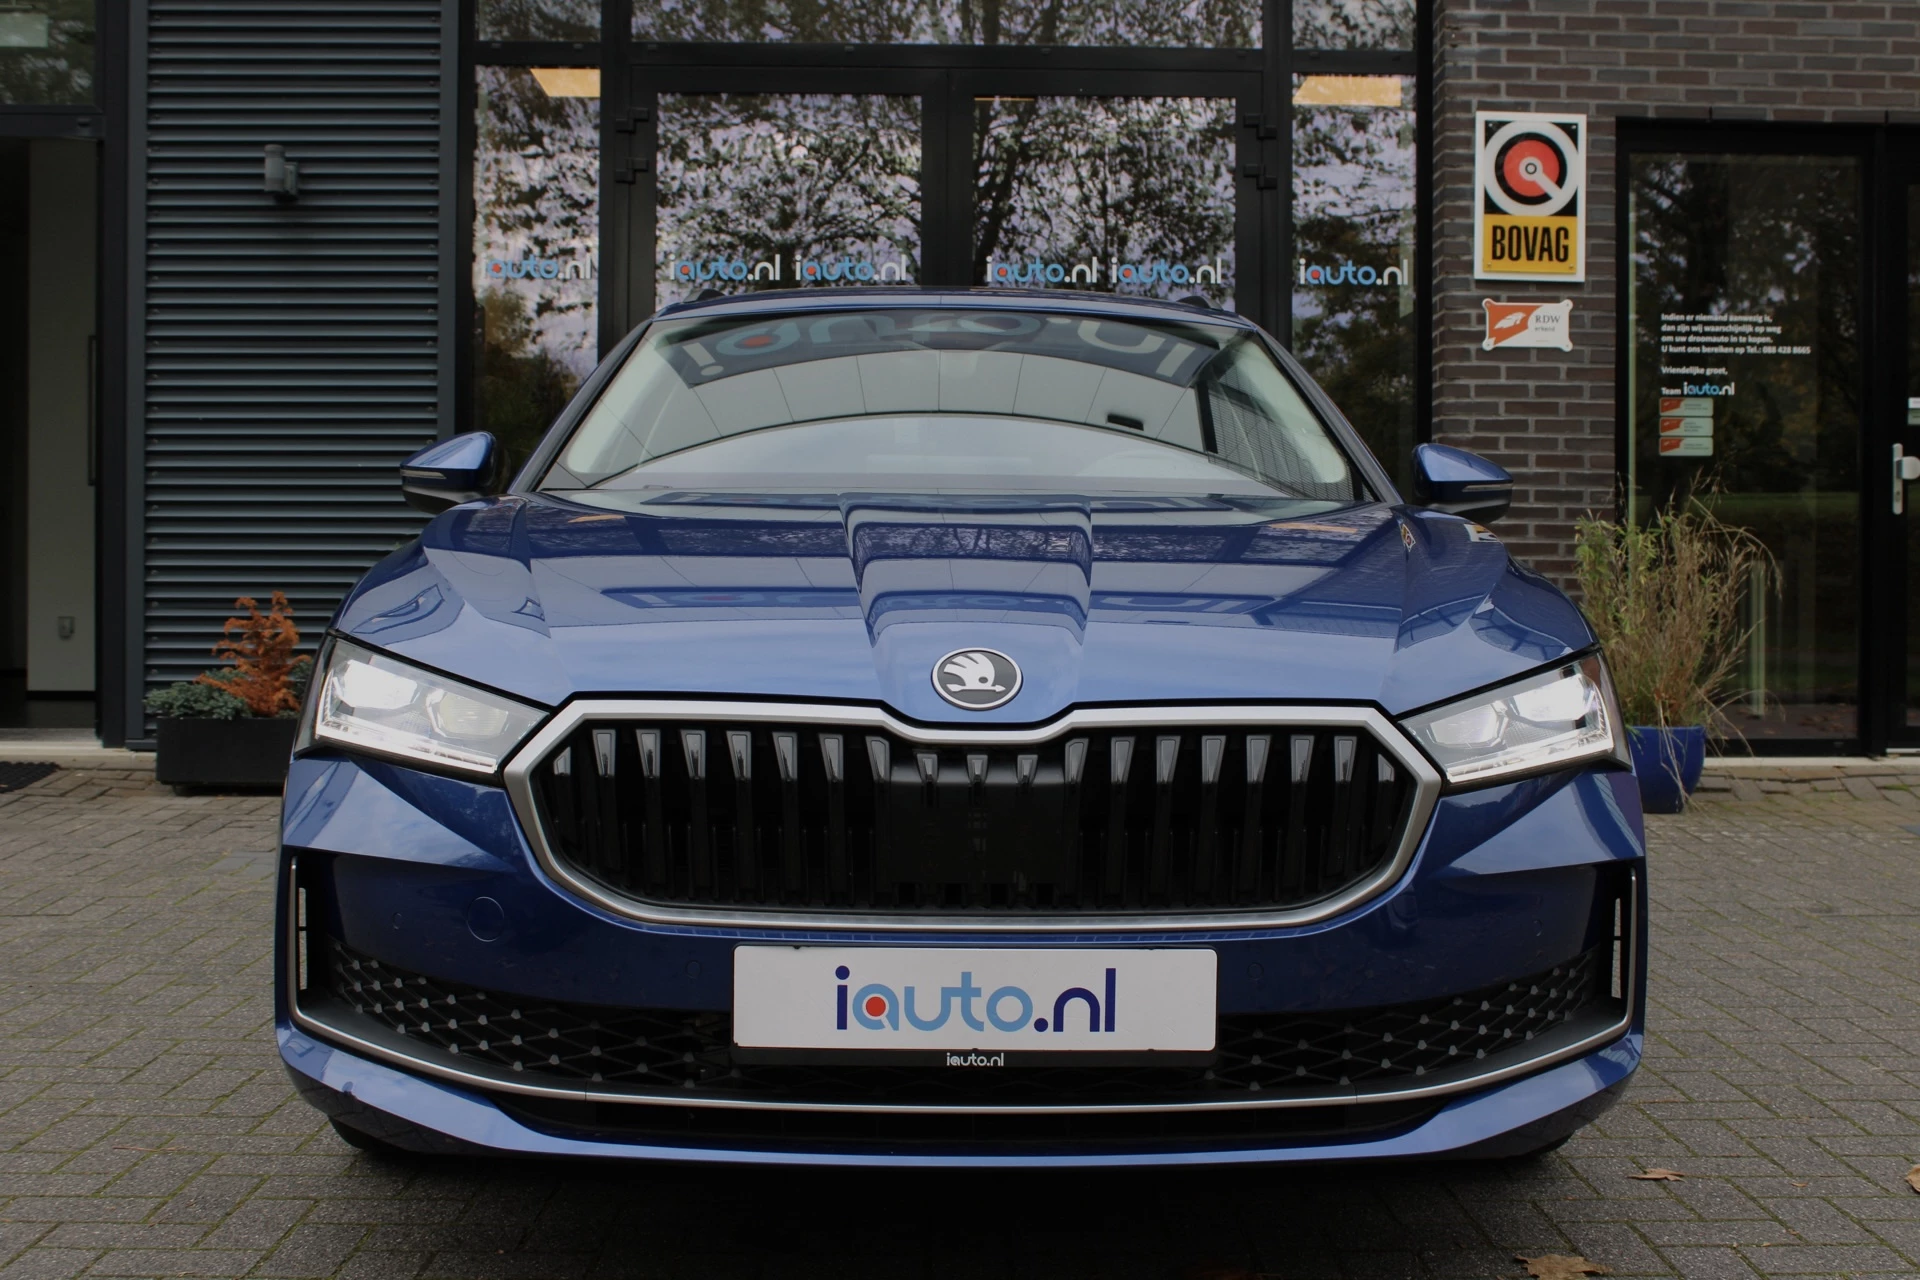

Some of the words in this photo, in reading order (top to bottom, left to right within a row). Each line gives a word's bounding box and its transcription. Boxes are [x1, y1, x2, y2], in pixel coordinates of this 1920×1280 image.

[1491, 225, 1570, 263] BOVAG
[482, 254, 592, 281] iauto.nl
[669, 255, 781, 281] iauto.nl
[795, 254, 908, 281] iauto.nl
[986, 256, 1098, 283] iauto.nl
[1111, 257, 1223, 284] iauto.nl
[1299, 258, 1409, 286] iauto.nl
[1535, 315, 1561, 324] RDW
[1661, 313, 1685, 321] Indien
[1695, 313, 1728, 321] niemand
[1729, 314, 1763, 323] aanwezig
[1661, 324, 1676, 332] dan
[1677, 324, 1690, 333] zijn
[1691, 324, 1703, 333] wij
[1704, 324, 1754, 333] waarschijnlijk
[1766, 326, 1782, 334] weg
[1748, 335, 1773, 344] kopen.
[1669, 345, 1686, 353] kunt
[1701, 345, 1734, 353] bereiken
[1735, 347, 1745, 355] op
[1661, 366, 1705, 375] Vriendelijke
[1705, 367, 1728, 375] groet,
[1661, 387, 1682, 395] Team
[1683, 382, 1735, 395] iauto.nl
[834, 965, 1117, 1033] iauto.nl
[946, 1052, 1004, 1067] iauto.nl
